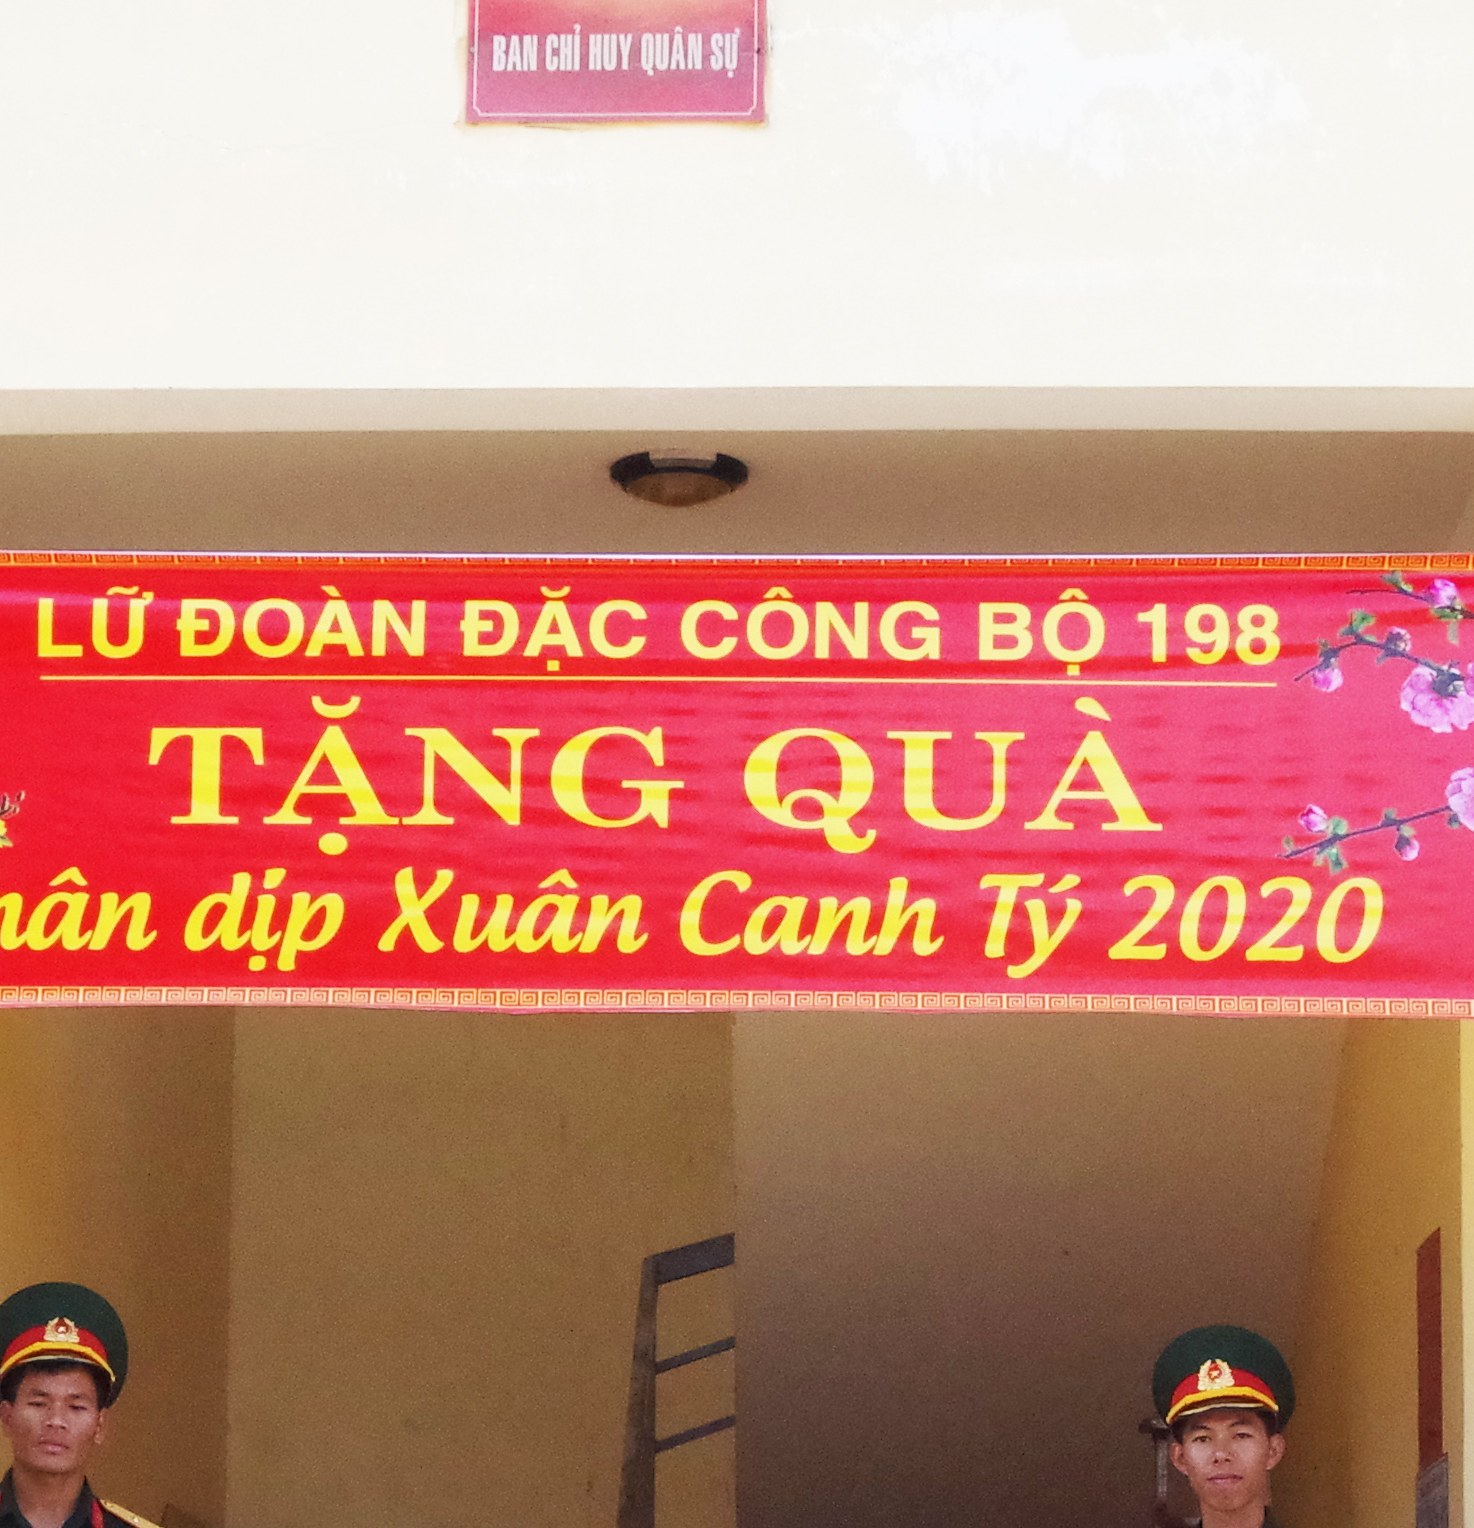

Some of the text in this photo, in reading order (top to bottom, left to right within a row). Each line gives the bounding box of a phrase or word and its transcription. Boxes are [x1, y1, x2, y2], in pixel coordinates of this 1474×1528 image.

[492, 23, 741, 78] BAN CHỈ HUY QUÂN SỰ
[37, 585, 1281, 677] LỮ ĐOÀN ĐẶC CÔNG BỘ 198
[147, 695, 1164, 856] TẶNG QUÀ
[183, 866, 345, 972] dịp
[377, 866, 649, 955] Xuân
[678, 869, 945, 957] Canh
[978, 873, 1083, 980] Tý
[1107, 874, 1385, 964] 2020
